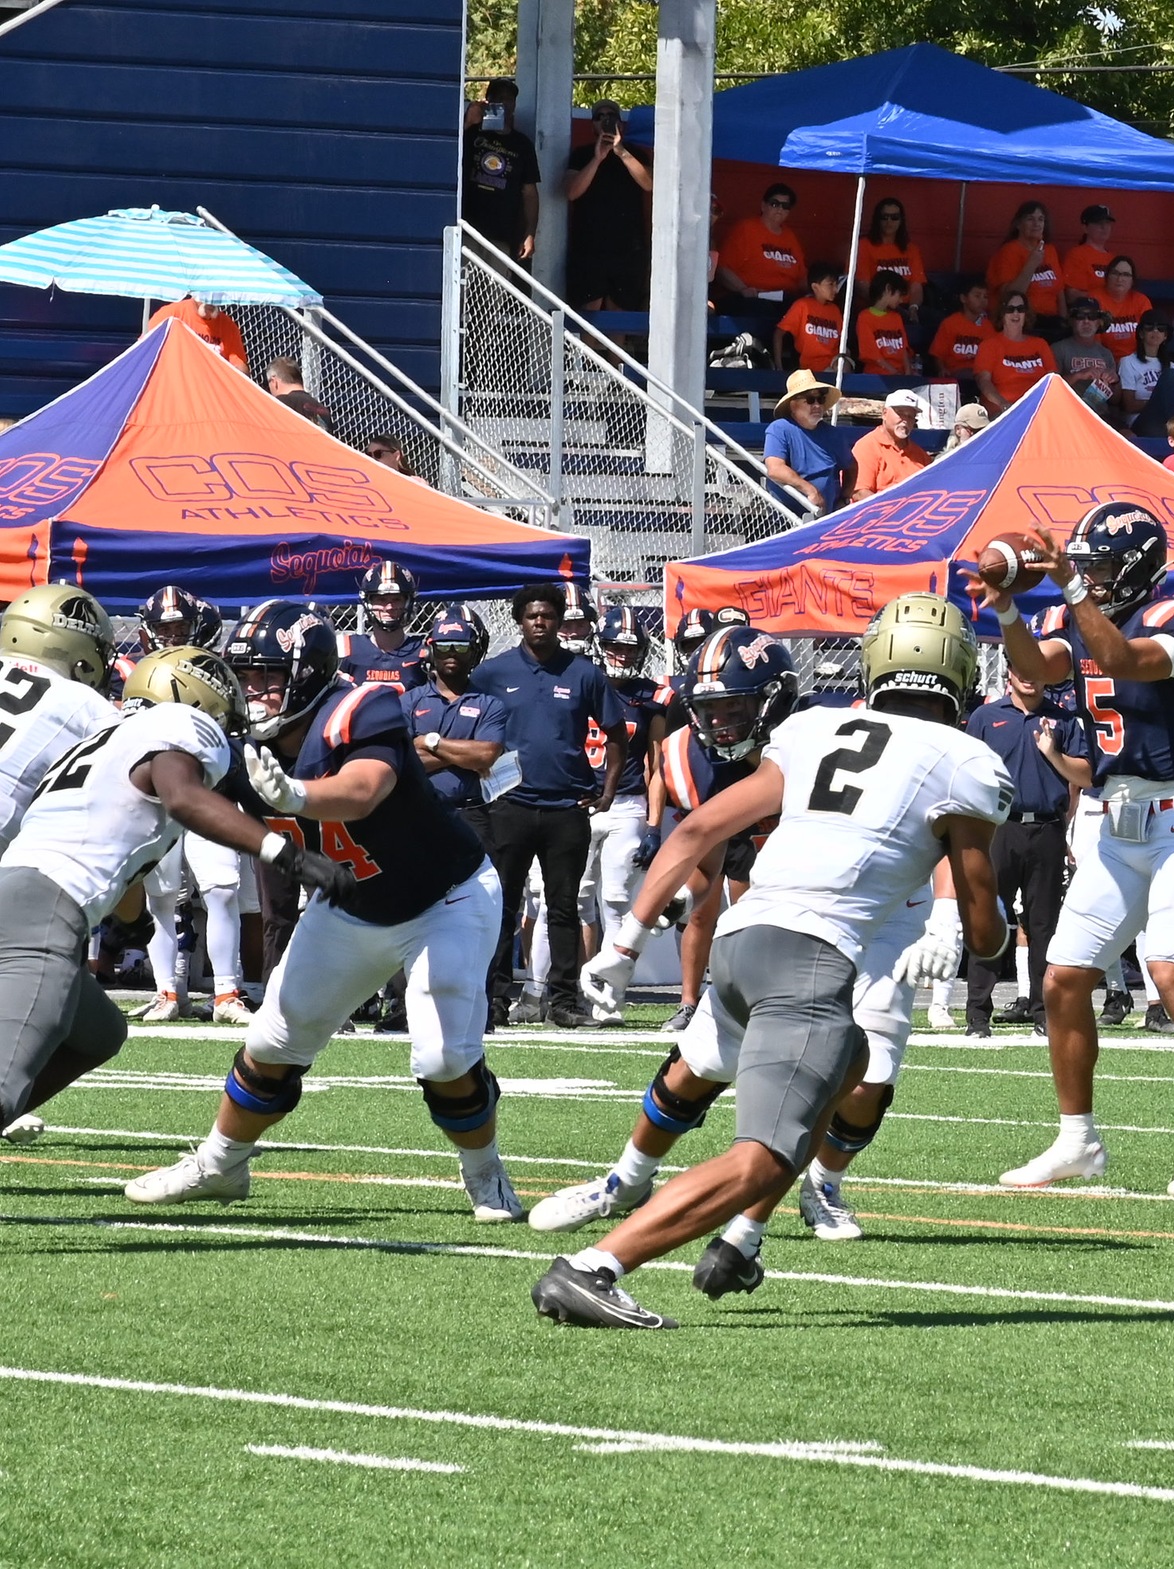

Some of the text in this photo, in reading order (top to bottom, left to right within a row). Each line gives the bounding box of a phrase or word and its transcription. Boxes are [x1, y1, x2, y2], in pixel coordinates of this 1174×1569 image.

[763, 251, 797, 264] GIANTS
[805, 323, 839, 339] GIANTS
[1002, 357, 1044, 368] GIANTS
[1071, 356, 1107, 369] COS
[0, 452, 101, 505] OS
[128, 452, 394, 514] COS
[180, 506, 411, 531] ATHLETICS
[819, 488, 988, 541] COS
[792, 533, 929, 555] ATHLETICS
[269, 539, 383, 596] Sequoias
[734, 564, 875, 620] GIANTS
[366, 669, 400, 681] SEQUOIAS
[894, 668, 939, 685] schutt
[1084, 677, 1126, 757] 5
[806, 717, 894, 818] 2
